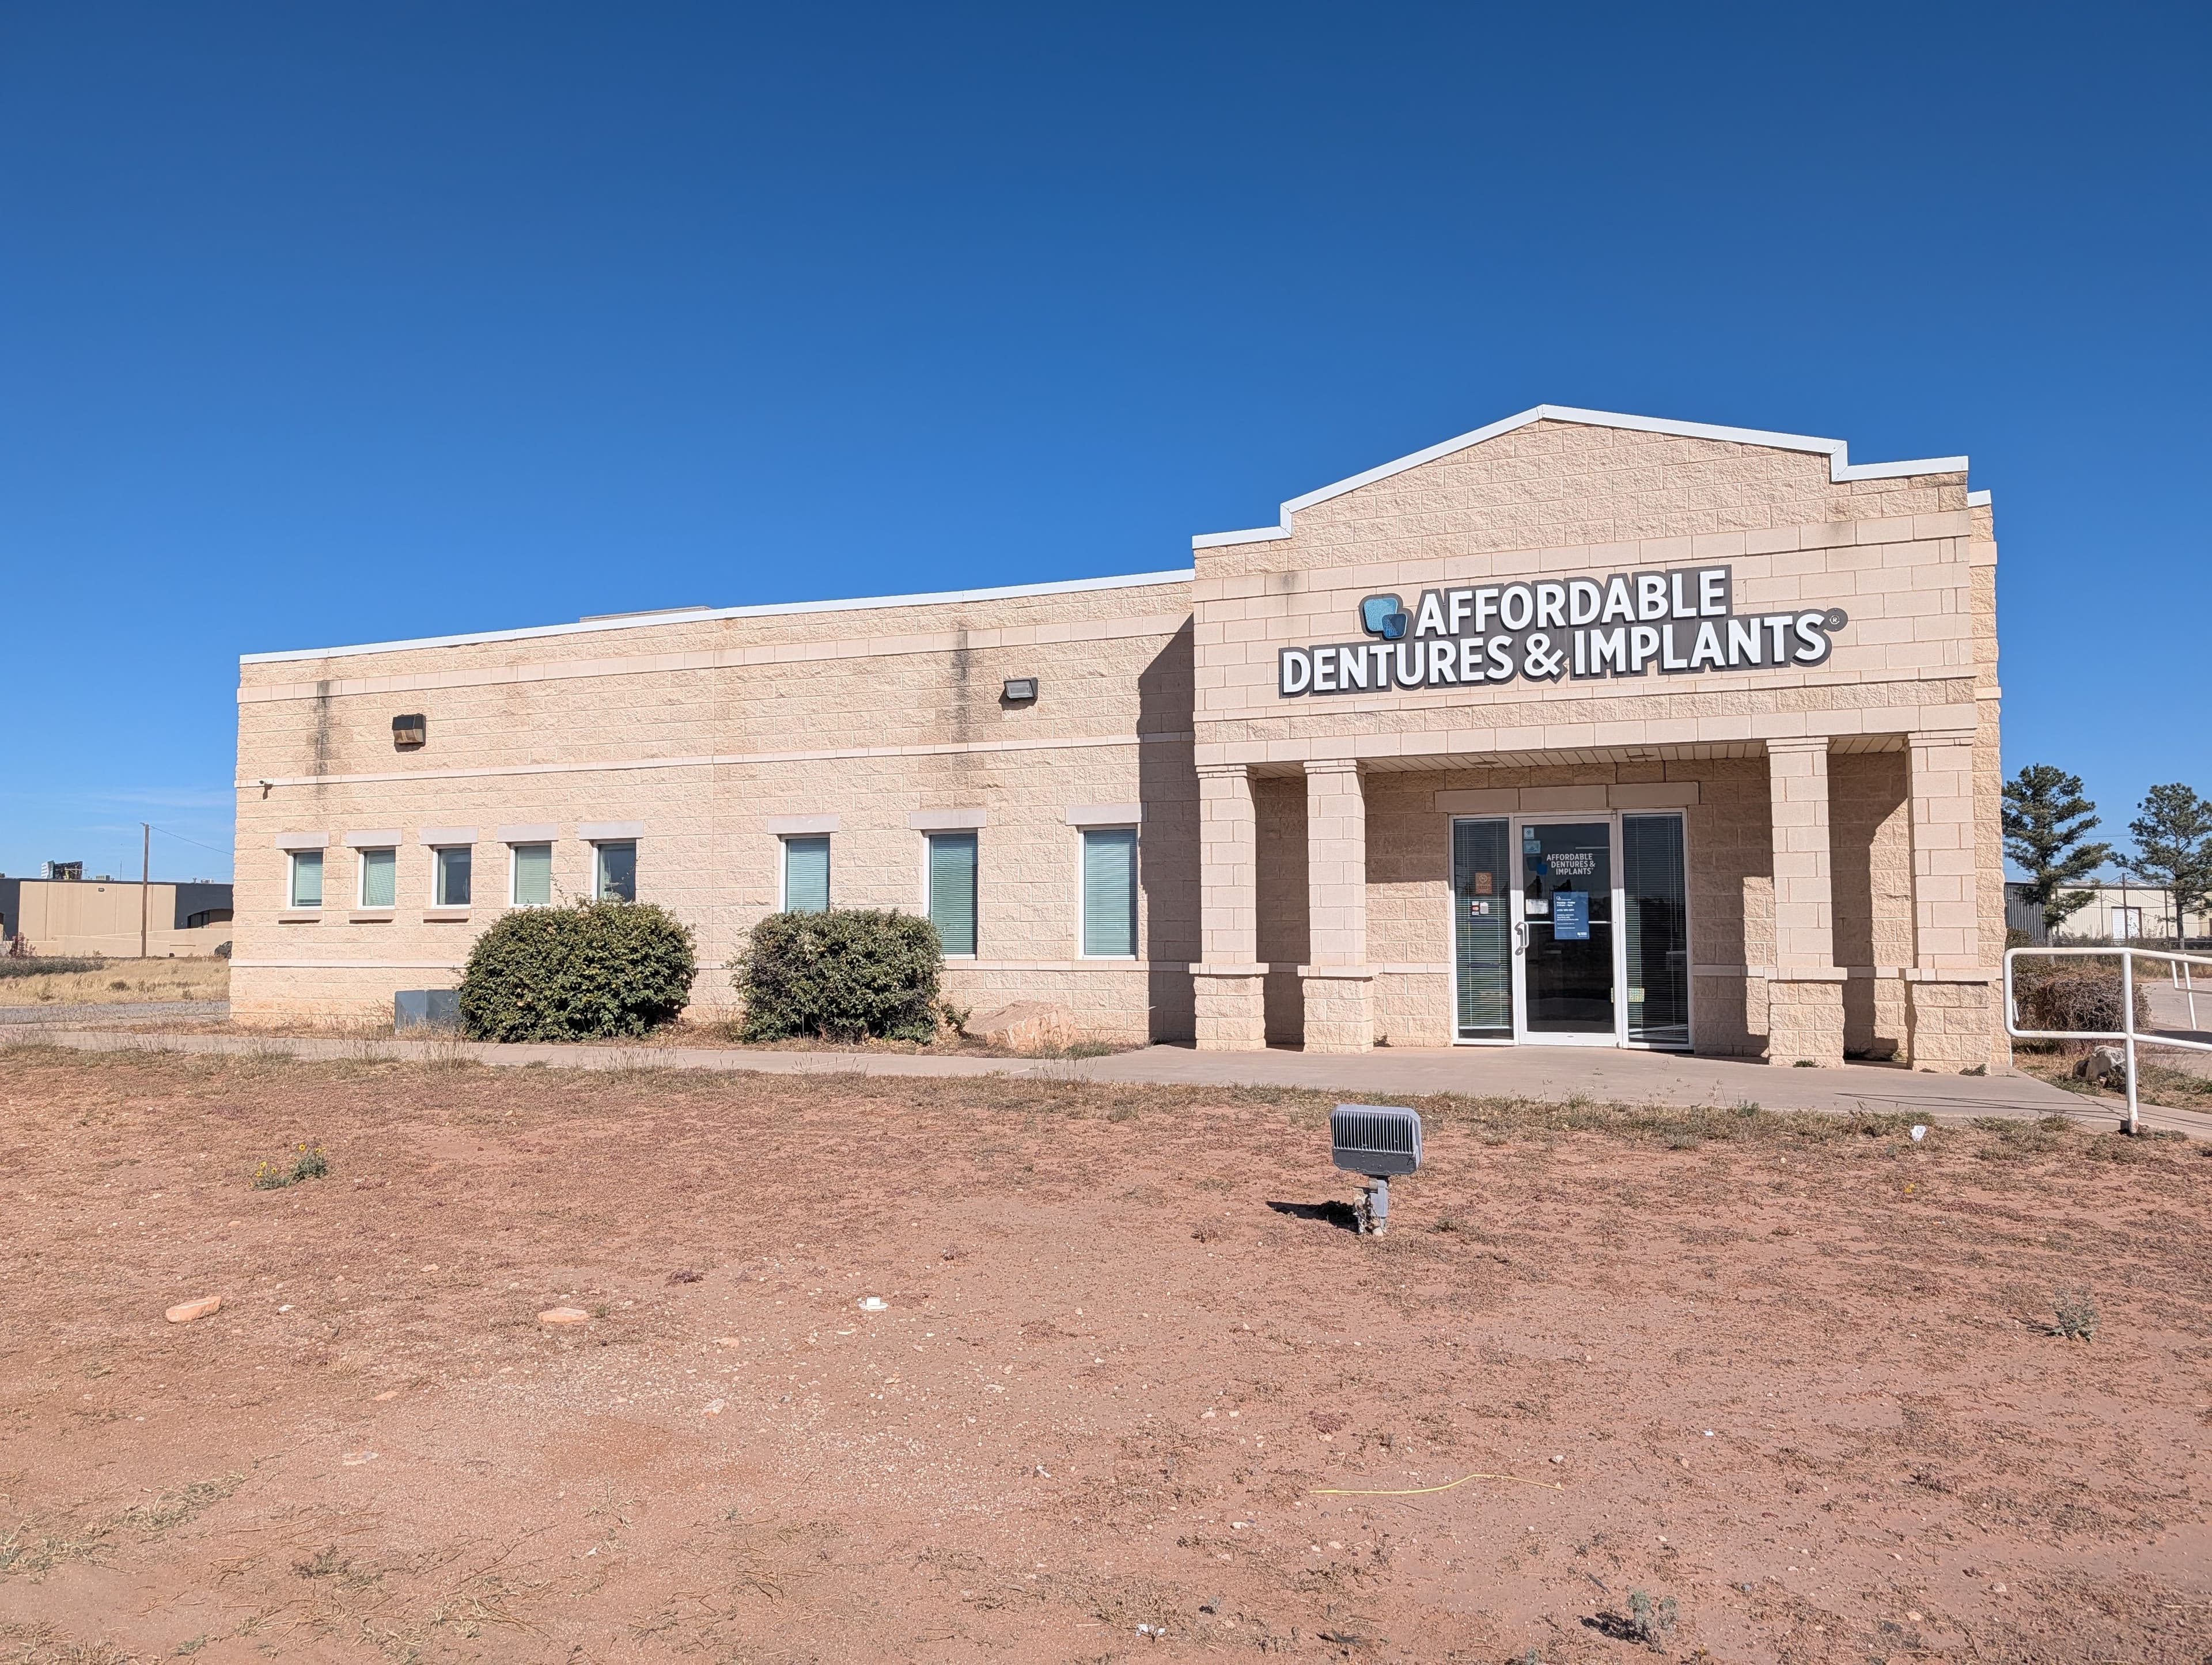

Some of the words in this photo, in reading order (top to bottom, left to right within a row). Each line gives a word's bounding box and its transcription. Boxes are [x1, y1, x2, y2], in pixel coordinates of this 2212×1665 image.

[1415, 570, 1726, 638] AFFORDABLE
[1282, 635, 1514, 693] DENTURES
[1524, 632, 1564, 677] &
[1551, 860, 1589, 868] DENTURES
